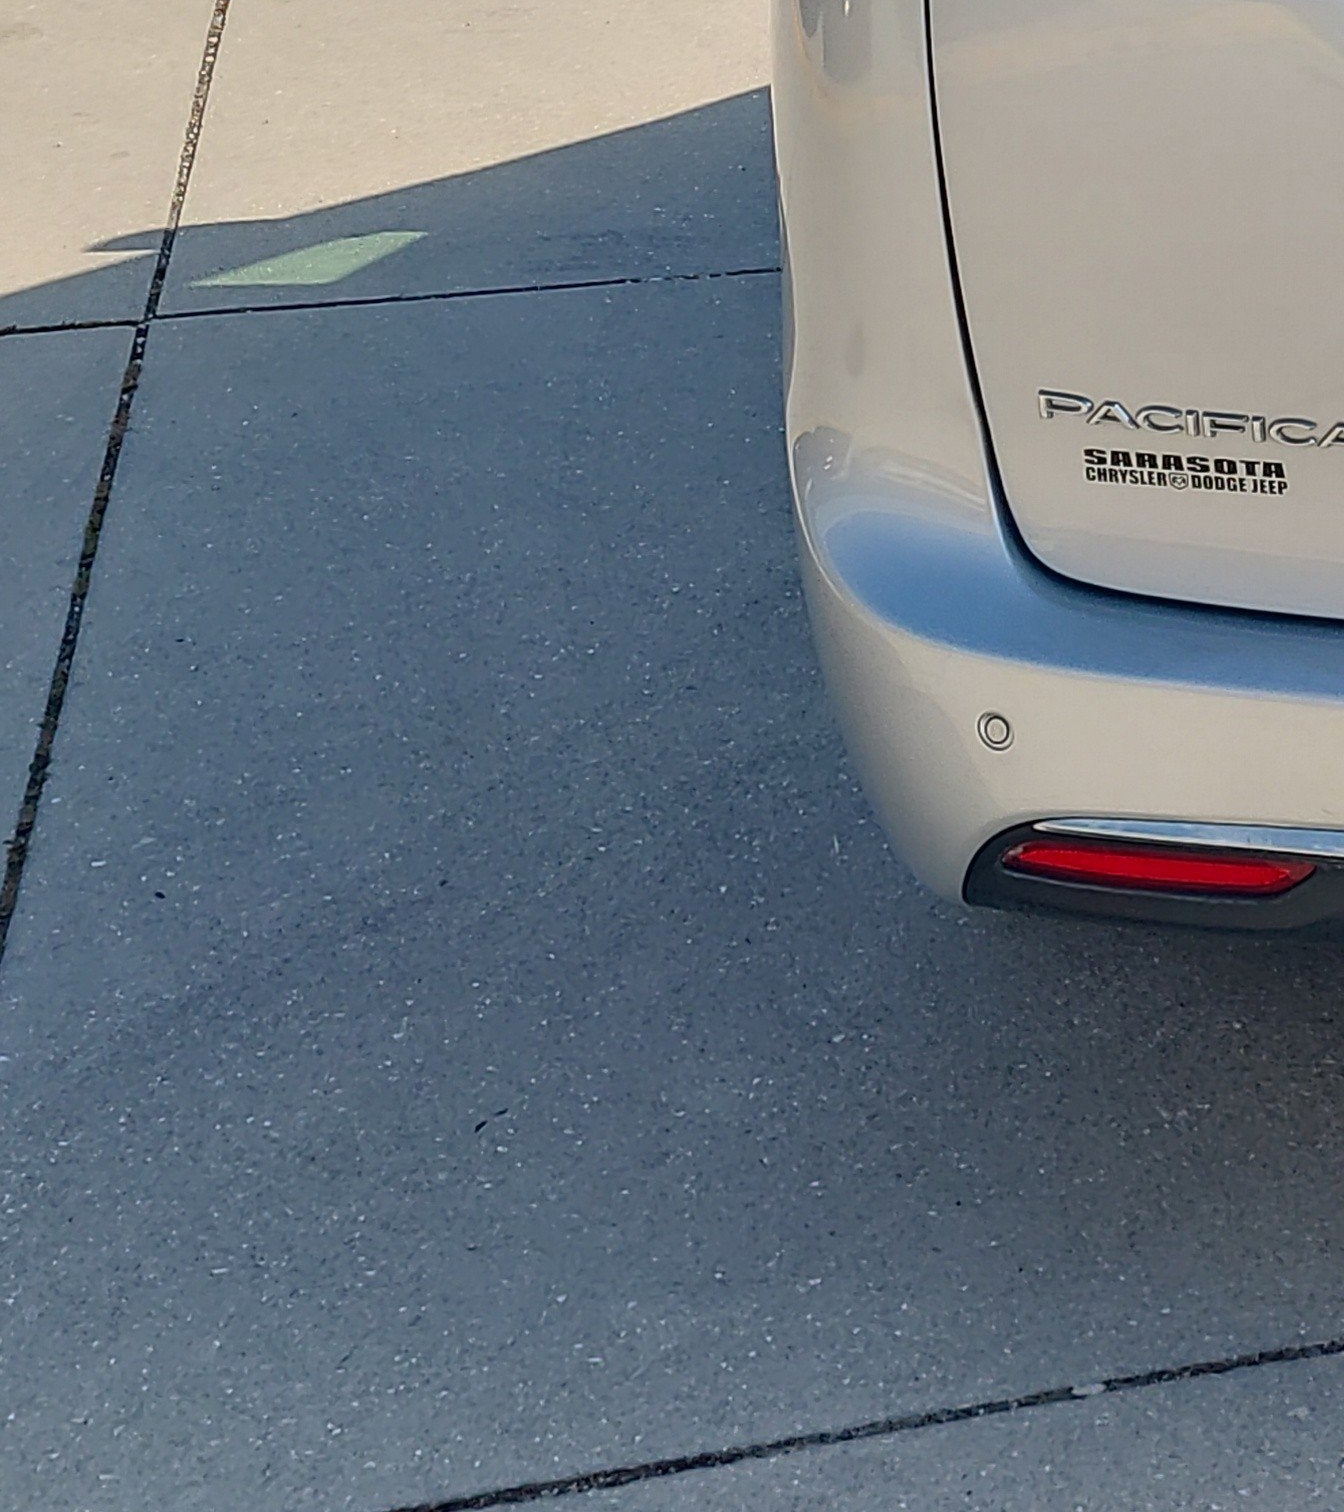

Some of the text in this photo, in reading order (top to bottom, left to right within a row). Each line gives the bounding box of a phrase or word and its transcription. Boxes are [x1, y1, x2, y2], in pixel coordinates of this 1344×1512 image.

[1084, 448, 1286, 479] SARASOTA
[1086, 466, 1289, 496] CHRYSLER DODGE JEEP
